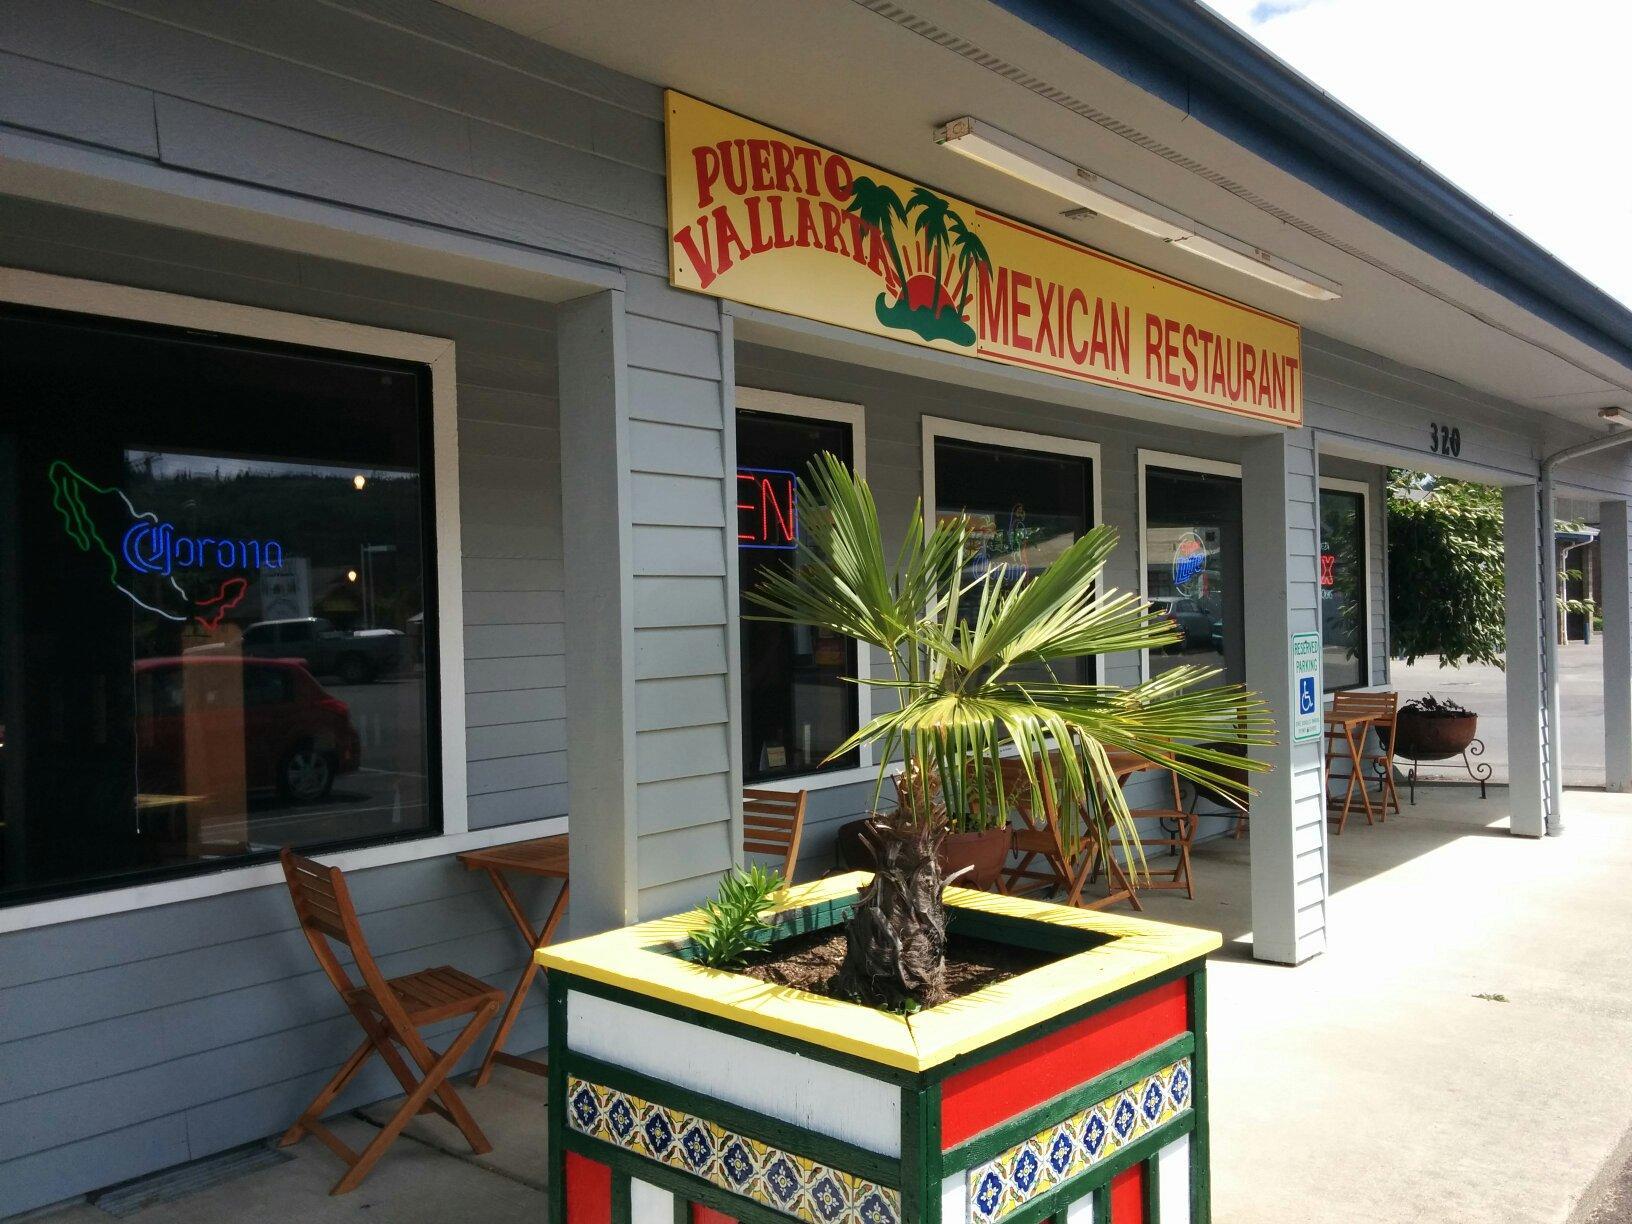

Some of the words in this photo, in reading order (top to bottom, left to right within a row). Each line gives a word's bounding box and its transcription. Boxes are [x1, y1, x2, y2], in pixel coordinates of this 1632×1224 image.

[691, 138, 854, 209] PUERTO
[673, 195, 897, 290] VALLARTA
[977, 258, 1130, 375] MEXICAN
[1145, 312, 1299, 414] RESTAURANT
[1430, 422, 1461, 457] 320
[122, 521, 283, 577] Corona
[1294, 640, 1319, 656] RESERVED
[1295, 658, 1318, 674] PARKING
